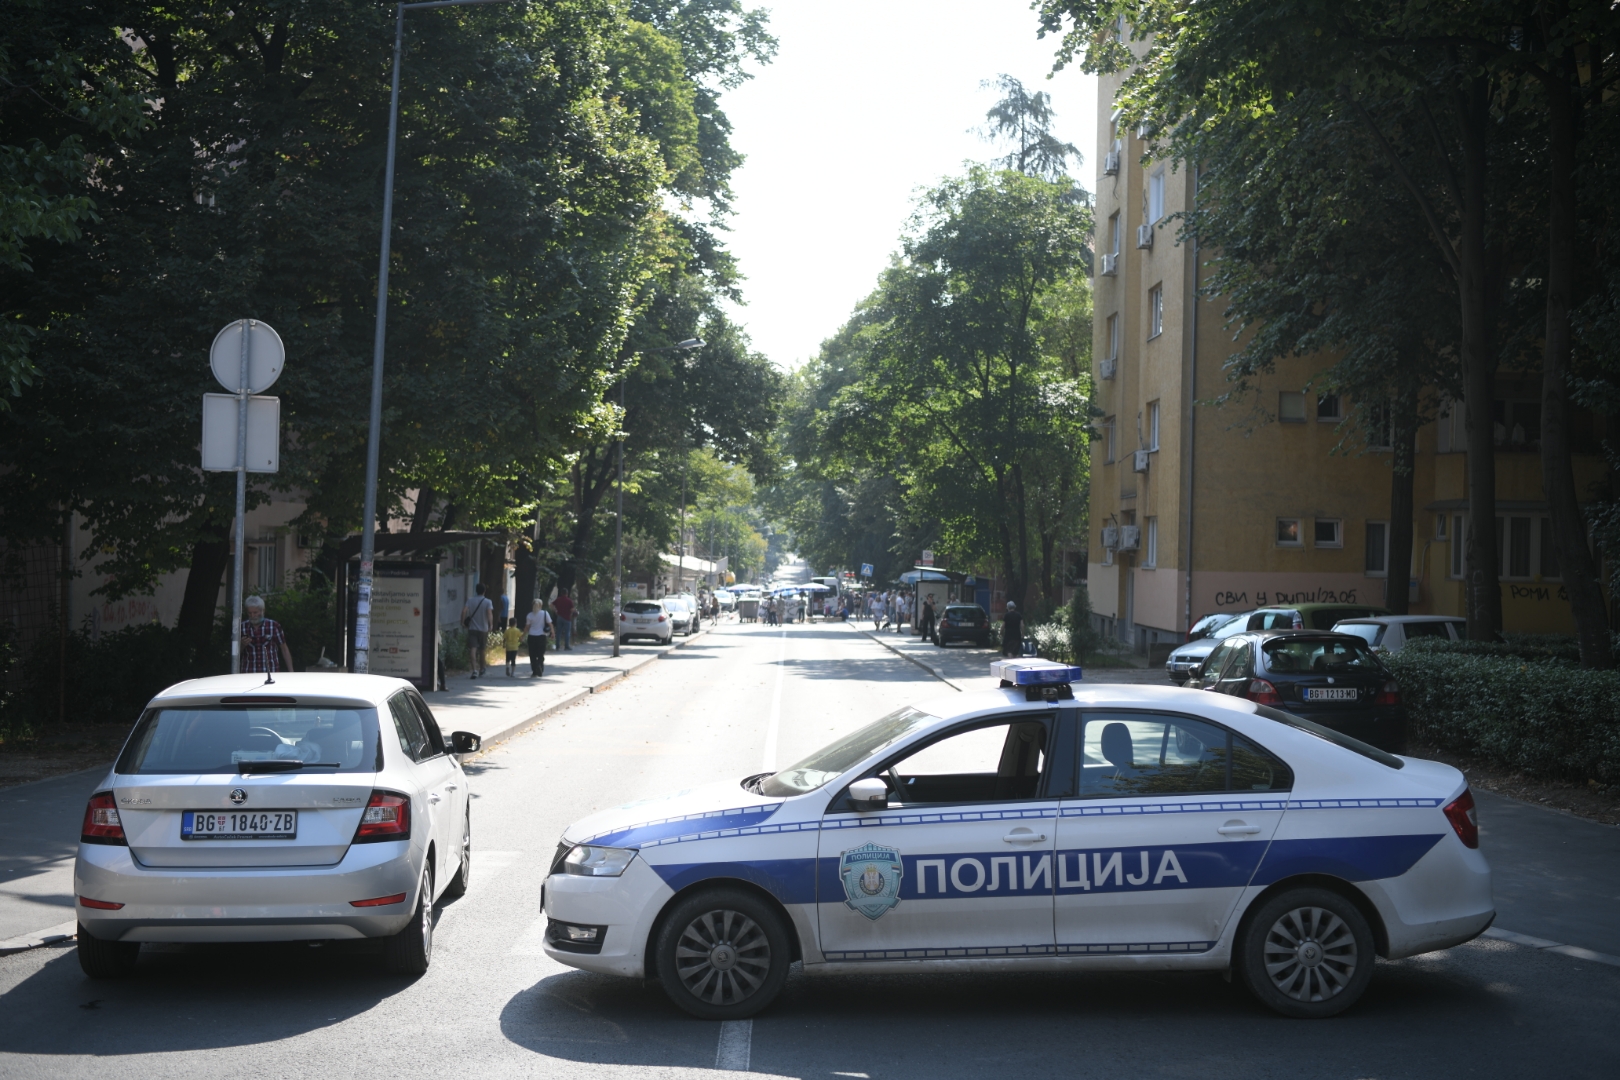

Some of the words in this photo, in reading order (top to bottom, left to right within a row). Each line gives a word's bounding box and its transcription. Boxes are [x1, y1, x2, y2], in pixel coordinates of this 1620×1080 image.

[1309, 689, 1319, 699] BG
[195, 814, 215, 832] BG
[851, 852, 891, 861] ПОЛИЦИЈА
[916, 850, 1188, 894] ПОЛИЦИЈА
